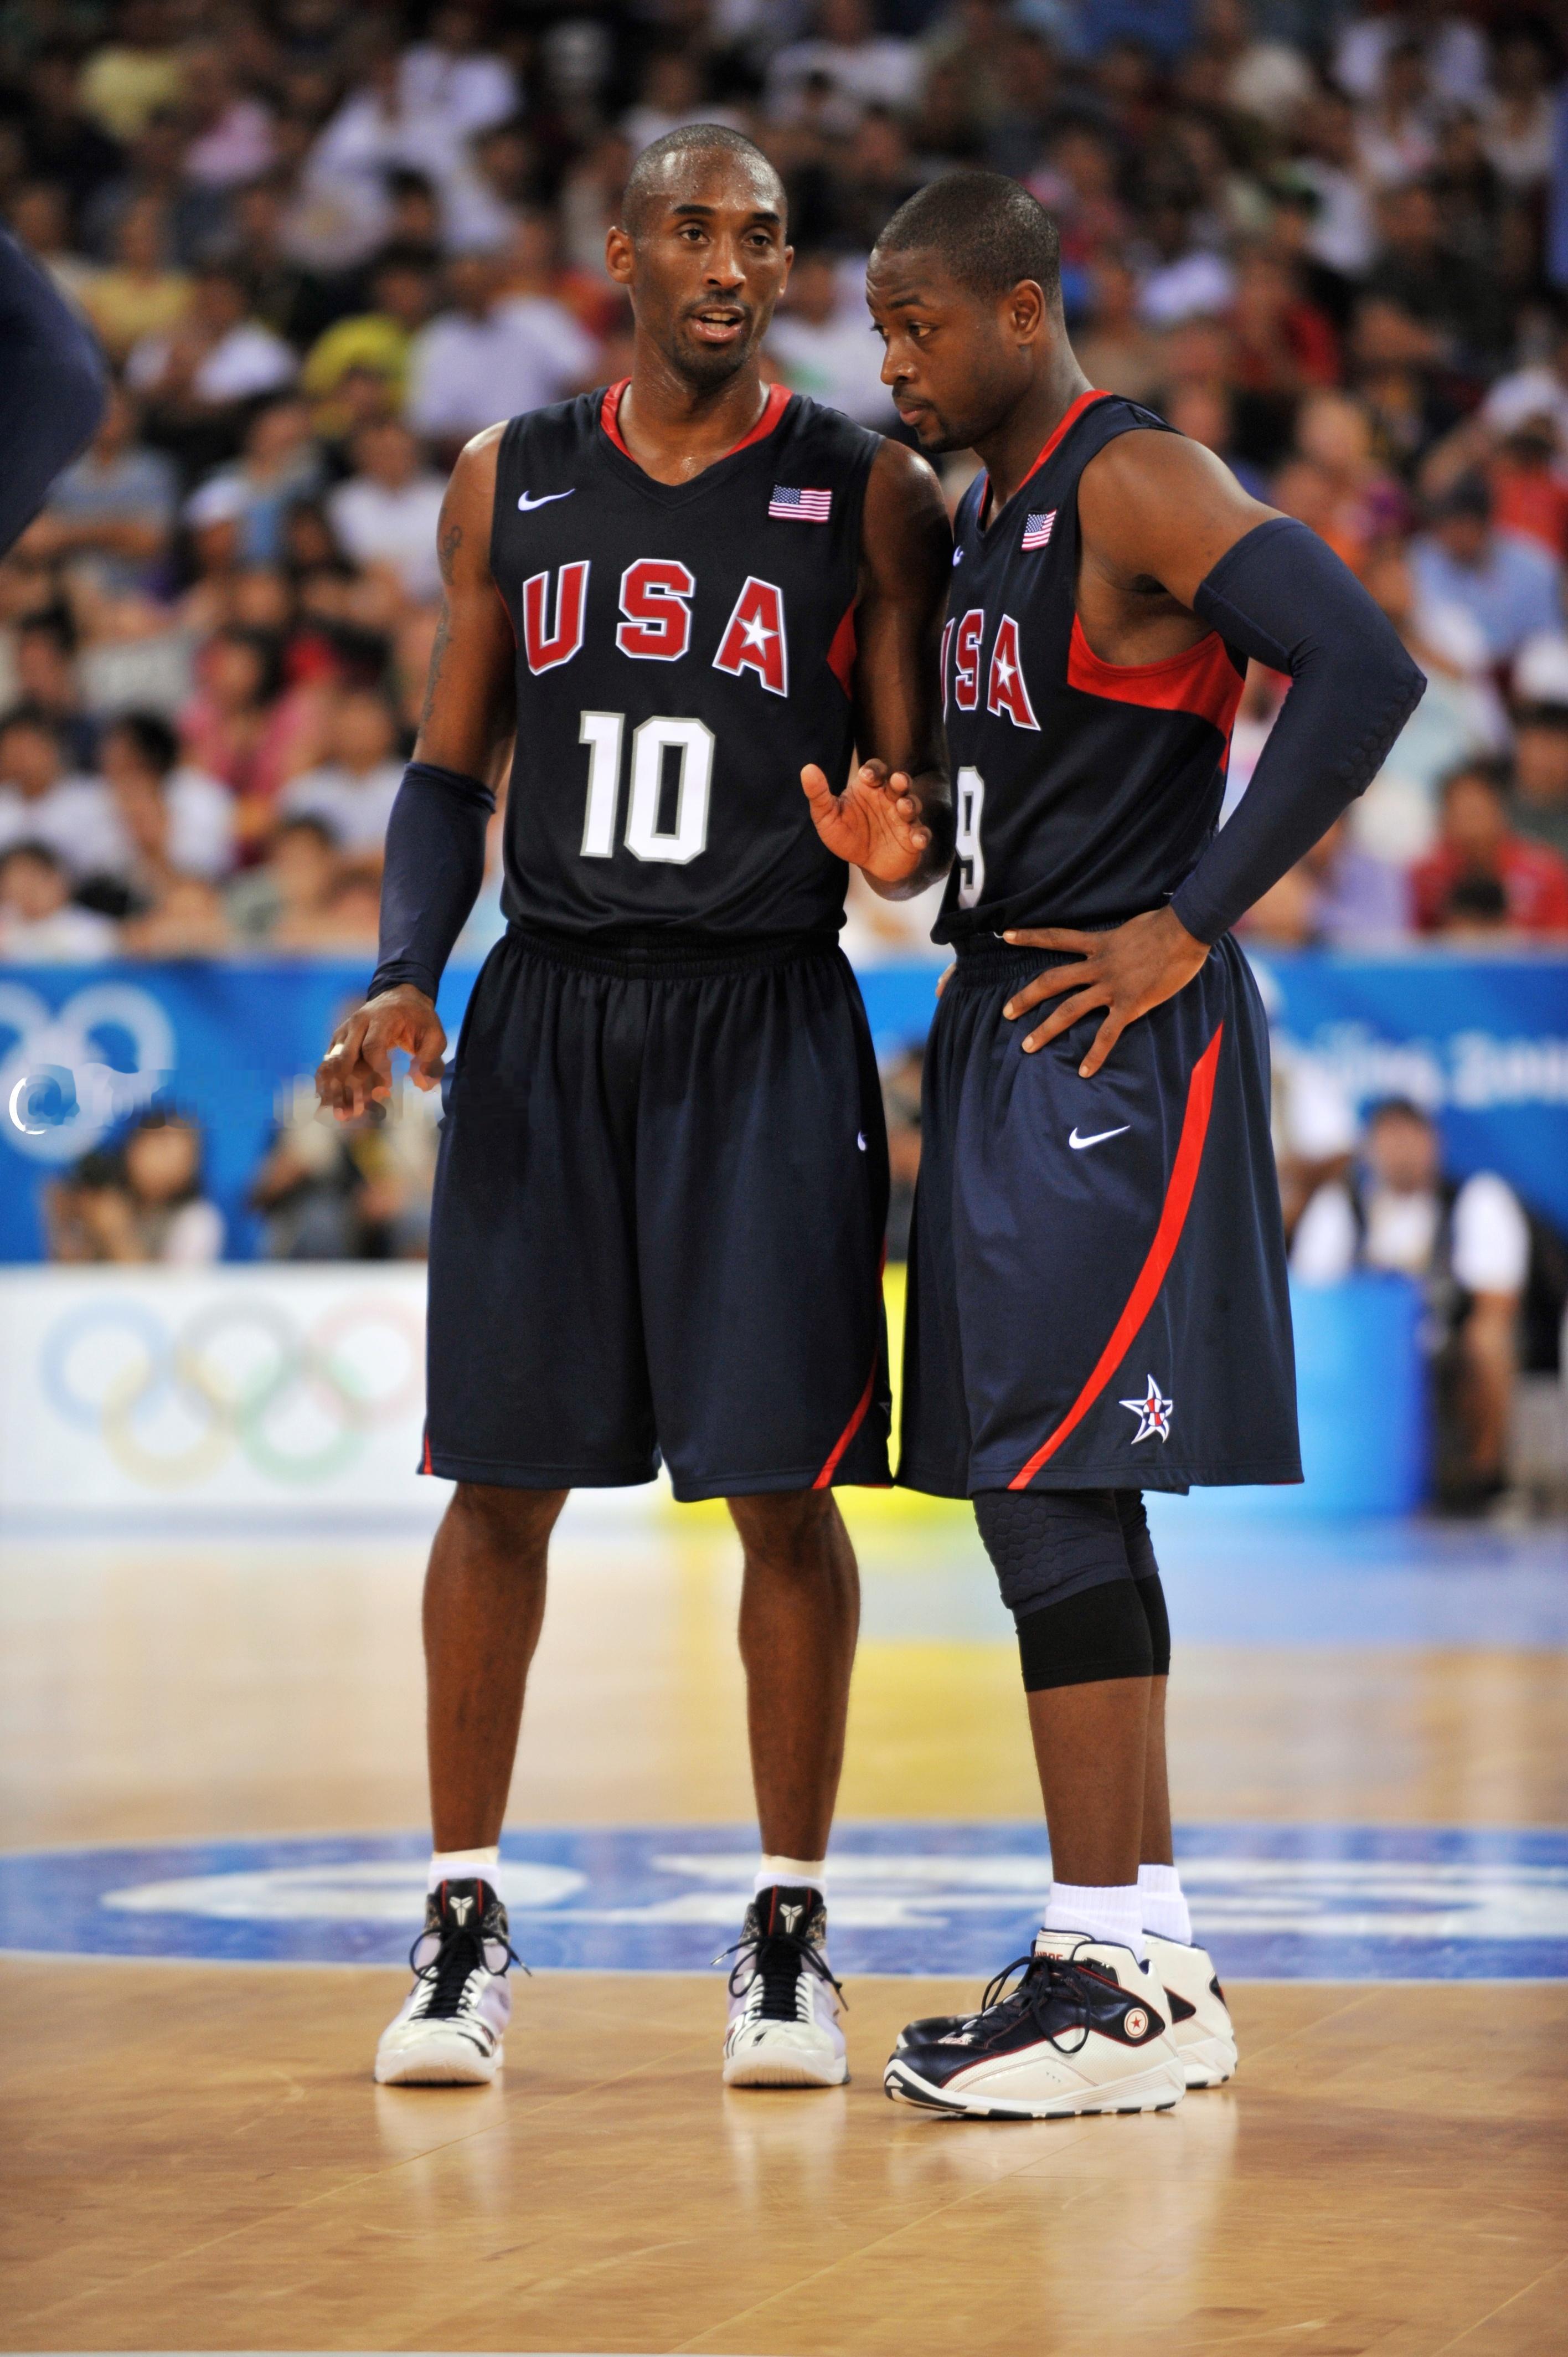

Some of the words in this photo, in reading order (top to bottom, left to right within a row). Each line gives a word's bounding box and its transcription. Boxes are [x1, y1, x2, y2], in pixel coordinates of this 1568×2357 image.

[523, 558, 788, 698] USA
[579, 710, 716, 865] 10
[955, 765, 985, 910] 9
